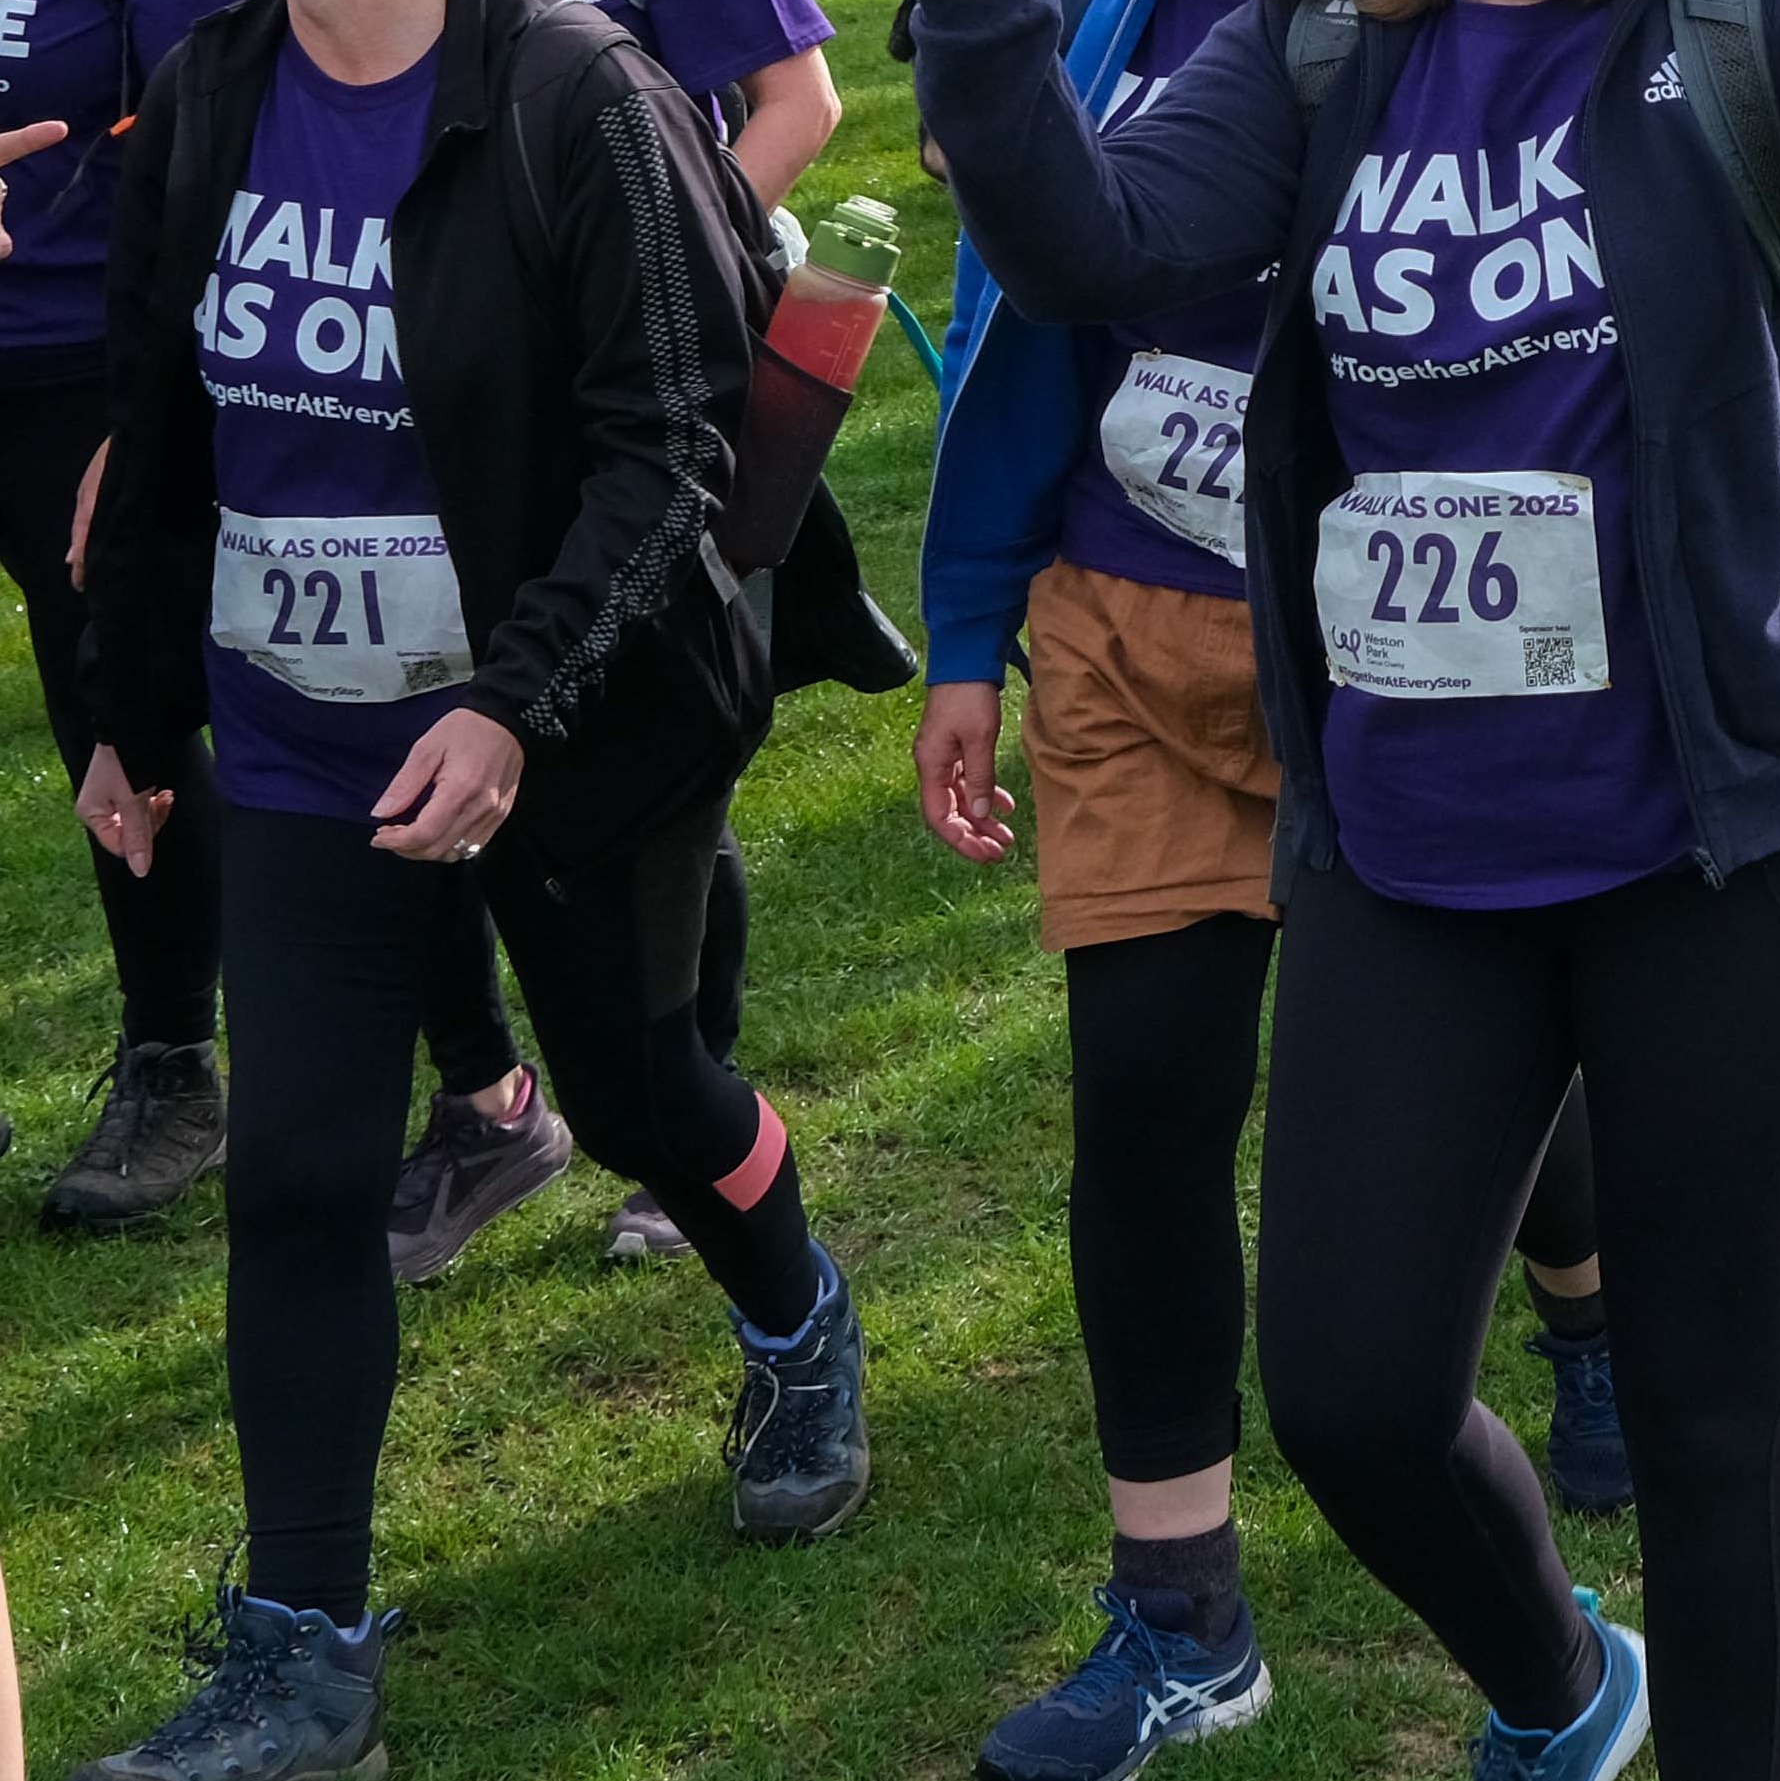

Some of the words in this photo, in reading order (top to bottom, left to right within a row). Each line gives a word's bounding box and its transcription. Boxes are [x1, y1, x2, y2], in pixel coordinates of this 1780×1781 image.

[1333, 115, 1586, 238] WALK
[1312, 243, 1436, 336] AS
[1468, 207, 1606, 322] ON
[295, 296, 404, 383] ON
[1330, 315, 1619, 387] #TogetherAtEveryS
[1133, 369, 1194, 401] WALK
[1194, 384, 1230, 410] AS
[1156, 411, 1246, 505] 22
[1339, 490, 1393, 517] WALK
[1392, 495, 1428, 519] AS
[1434, 495, 1502, 519] ONE
[1508, 494, 1580, 517] 2025
[221, 529, 275, 557] WALK
[280, 538, 315, 559] AS
[321, 537, 380, 558] ONE
[385, 535, 450, 557] 2025
[1367, 529, 1519, 624] 226
[262, 567, 386, 646] 221
[1364, 631, 1405, 649] Weston
[1365, 646, 1390, 660] Park
